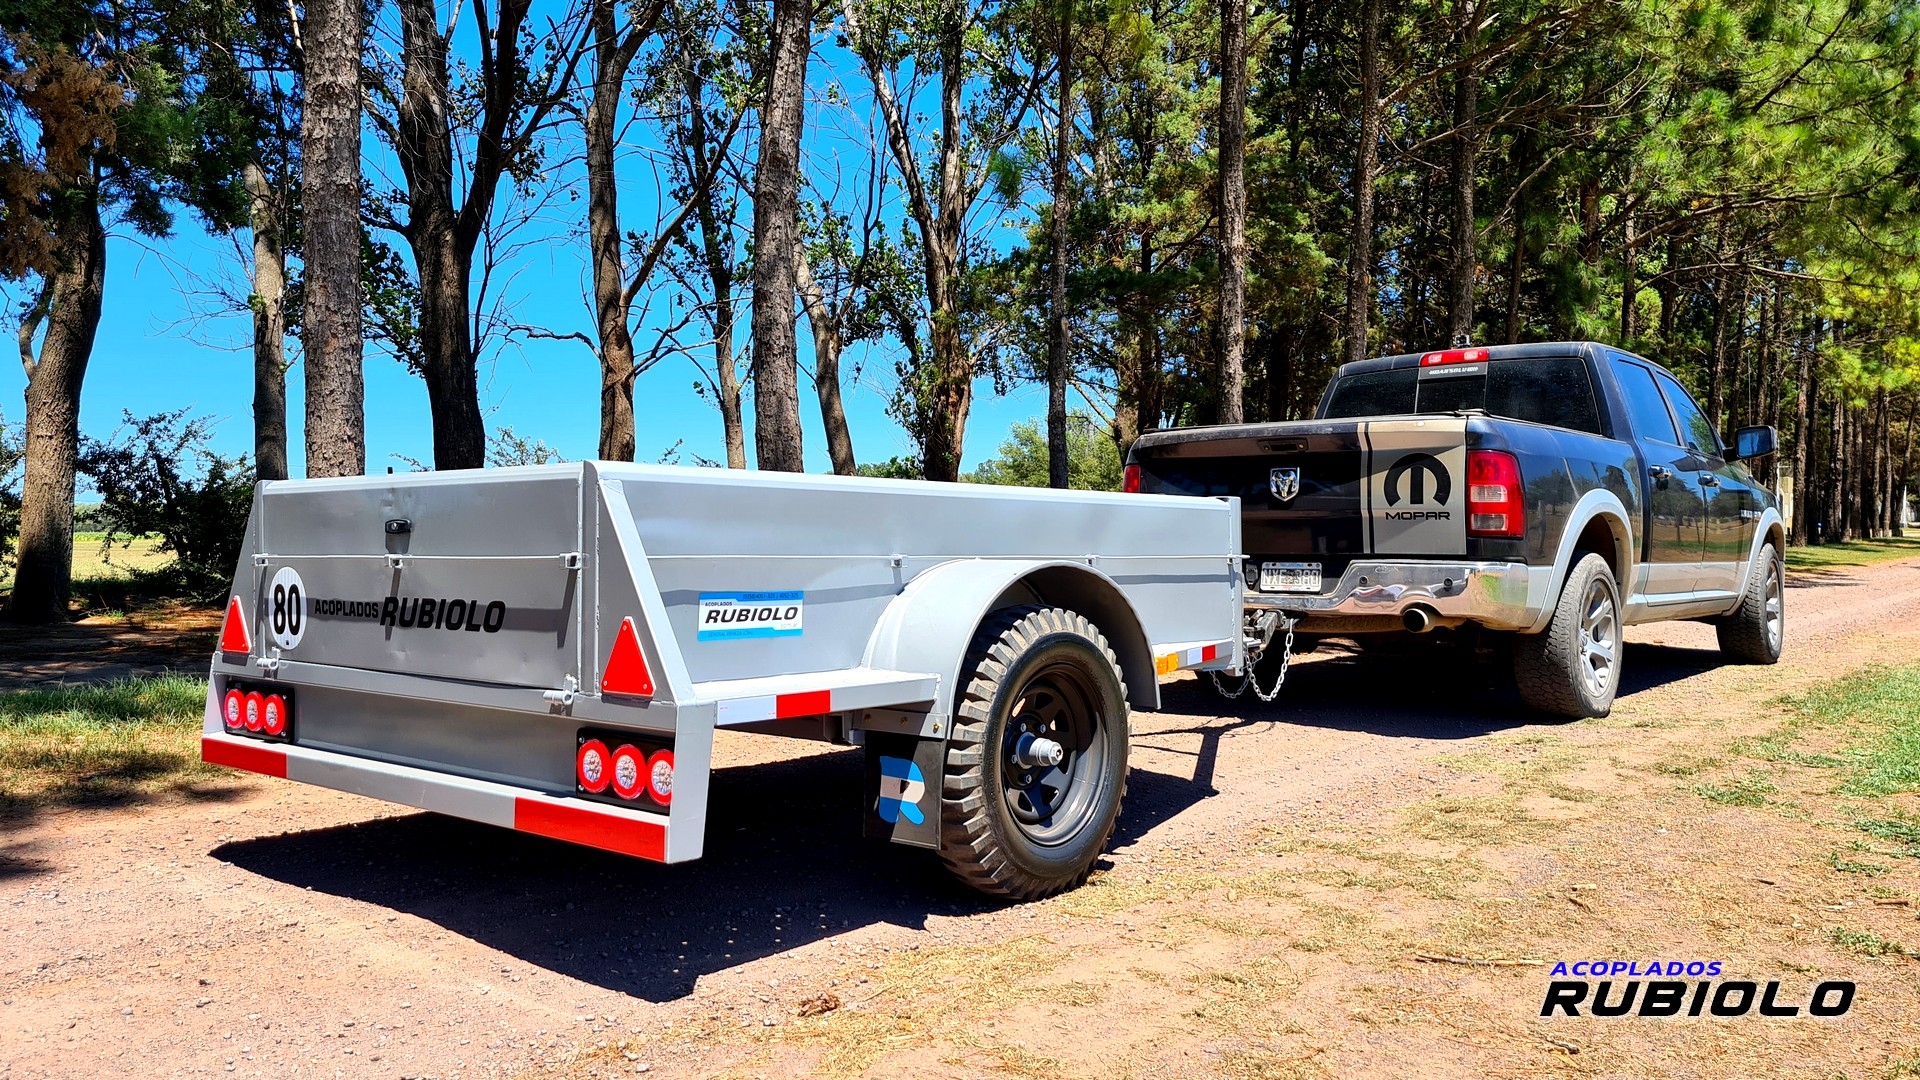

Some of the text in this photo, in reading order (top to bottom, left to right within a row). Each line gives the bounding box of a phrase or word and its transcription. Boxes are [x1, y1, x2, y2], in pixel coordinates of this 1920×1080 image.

[1385, 511, 1451, 521] MOPAR
[273, 583, 301, 636] 80
[314, 596, 506, 633] ACOPLADOS RUBIOLO
[704, 606, 799, 624] RUBIOLO
